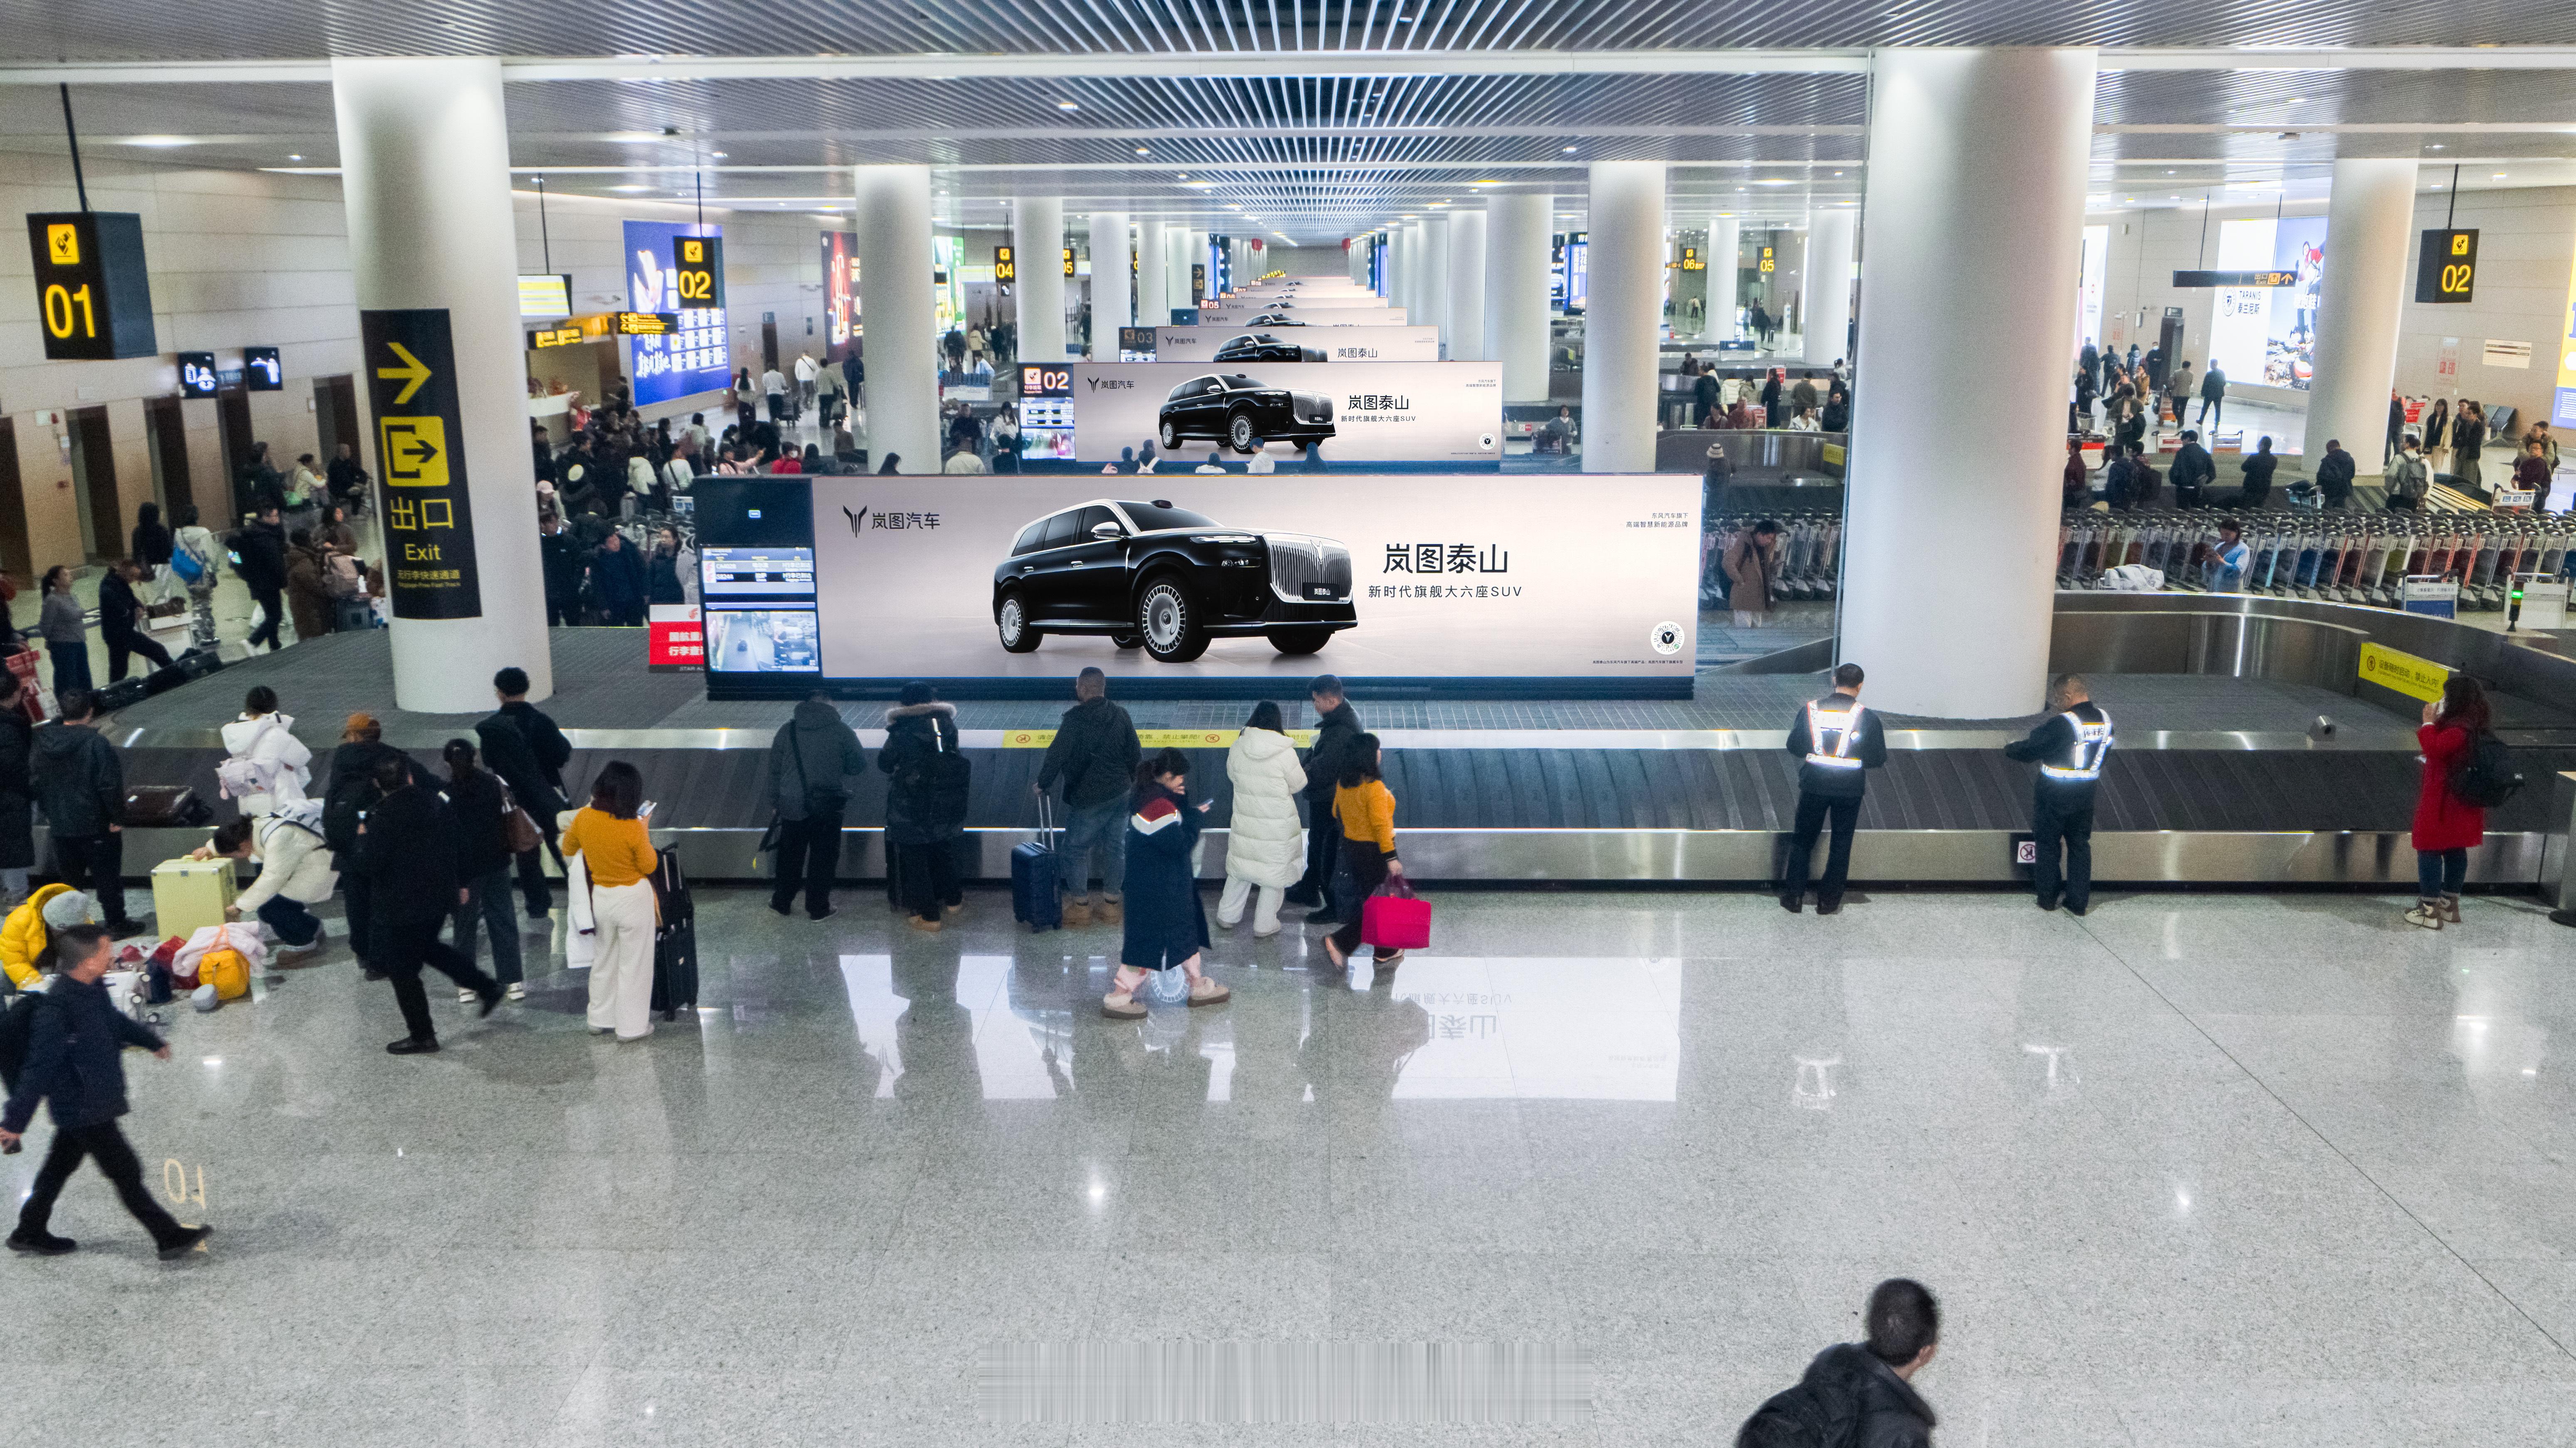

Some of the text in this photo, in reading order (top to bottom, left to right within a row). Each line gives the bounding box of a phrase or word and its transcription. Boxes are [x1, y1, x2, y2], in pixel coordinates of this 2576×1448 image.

[996, 263, 1014, 279] 04
[1683, 259, 1695, 270] 06
[1760, 260, 1775, 272] 05
[679, 270, 711, 300] 02
[2442, 264, 2472, 293] 02
[2239, 290, 2261, 300] TARANIS
[45, 284, 95, 339] 01
[2238, 303, 2260, 314] 泰兰尼斯
[1137, 332, 1153, 344] 03
[1338, 347, 1377, 358] 岚图泰山
[1043, 372, 1069, 390] 02
[1101, 380, 1134, 390] 岚图汽车
[1348, 395, 1409, 410] 岚图泰山
[391, 496, 454, 531] 出口
[871, 512, 941, 531] 岚图汽车
[405, 543, 441, 561] Exit
[1383, 543, 1508, 574] 岚图泰山
[1368, 585, 1523, 598] 新时代旗舰大六座SUV
